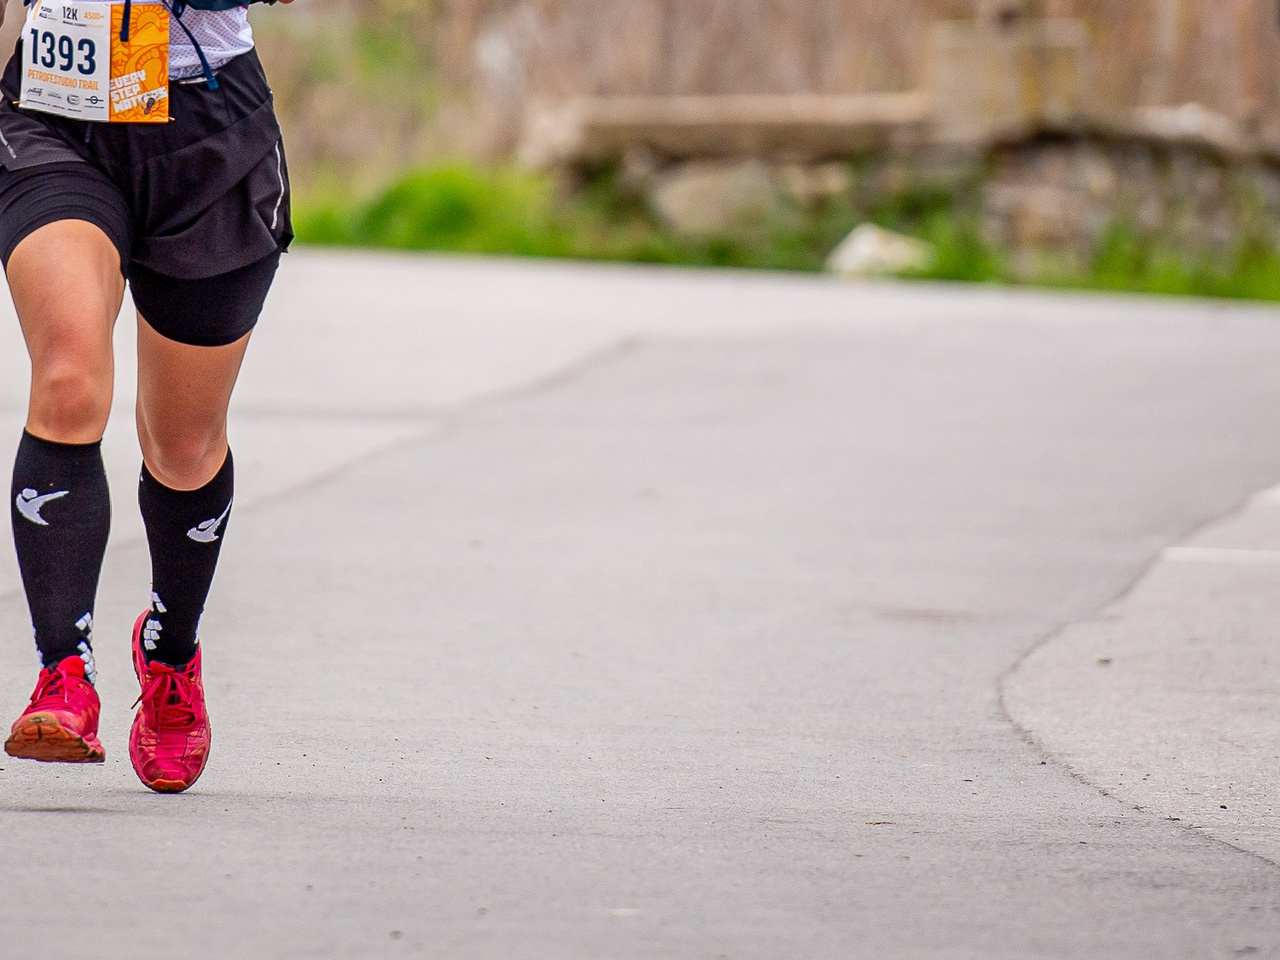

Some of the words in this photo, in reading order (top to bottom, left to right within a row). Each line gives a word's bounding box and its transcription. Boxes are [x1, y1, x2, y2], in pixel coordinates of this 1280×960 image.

[62, 6, 78, 20] 12K
[30, 28, 96, 75] 1393
[78, 78, 99, 90] TRAIL
[109, 69, 146, 90] EVERY
[110, 82, 141, 102] STEP
